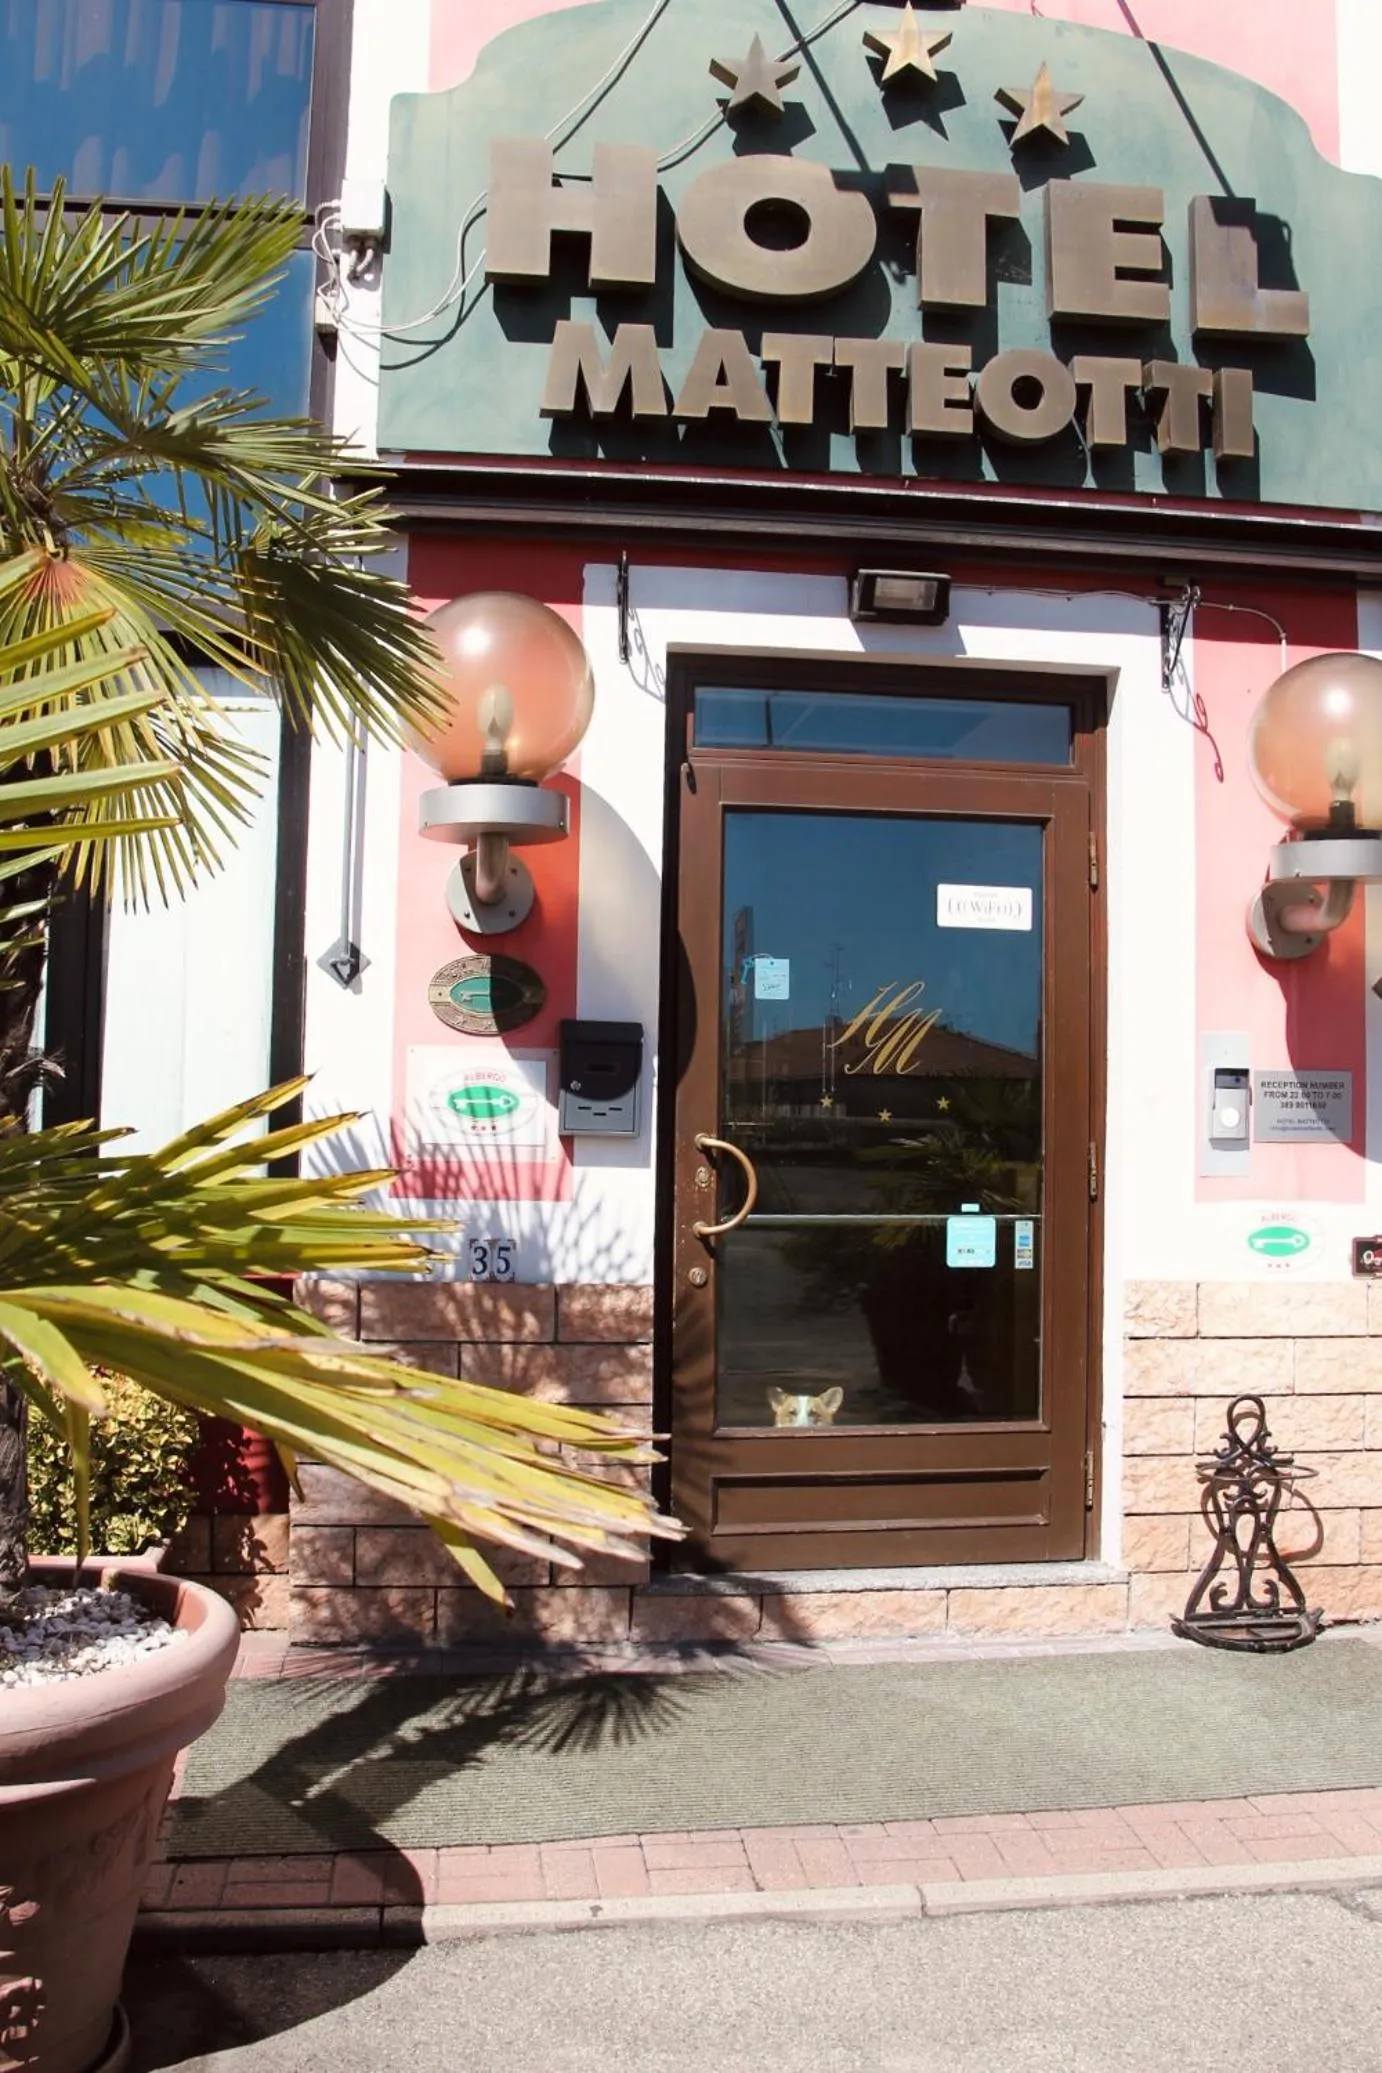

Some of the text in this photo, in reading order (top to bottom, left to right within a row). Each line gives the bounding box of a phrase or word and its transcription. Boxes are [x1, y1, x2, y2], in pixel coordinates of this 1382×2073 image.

[485, 137, 1310, 340] HOTEL
[539, 319, 1254, 461] MATTEOTTI
[1260, 1081, 1345, 1090] RECEPTION NUMBER
[1263, 1091, 1288, 1100] FROM
[472, 1246, 511, 1275] 35
